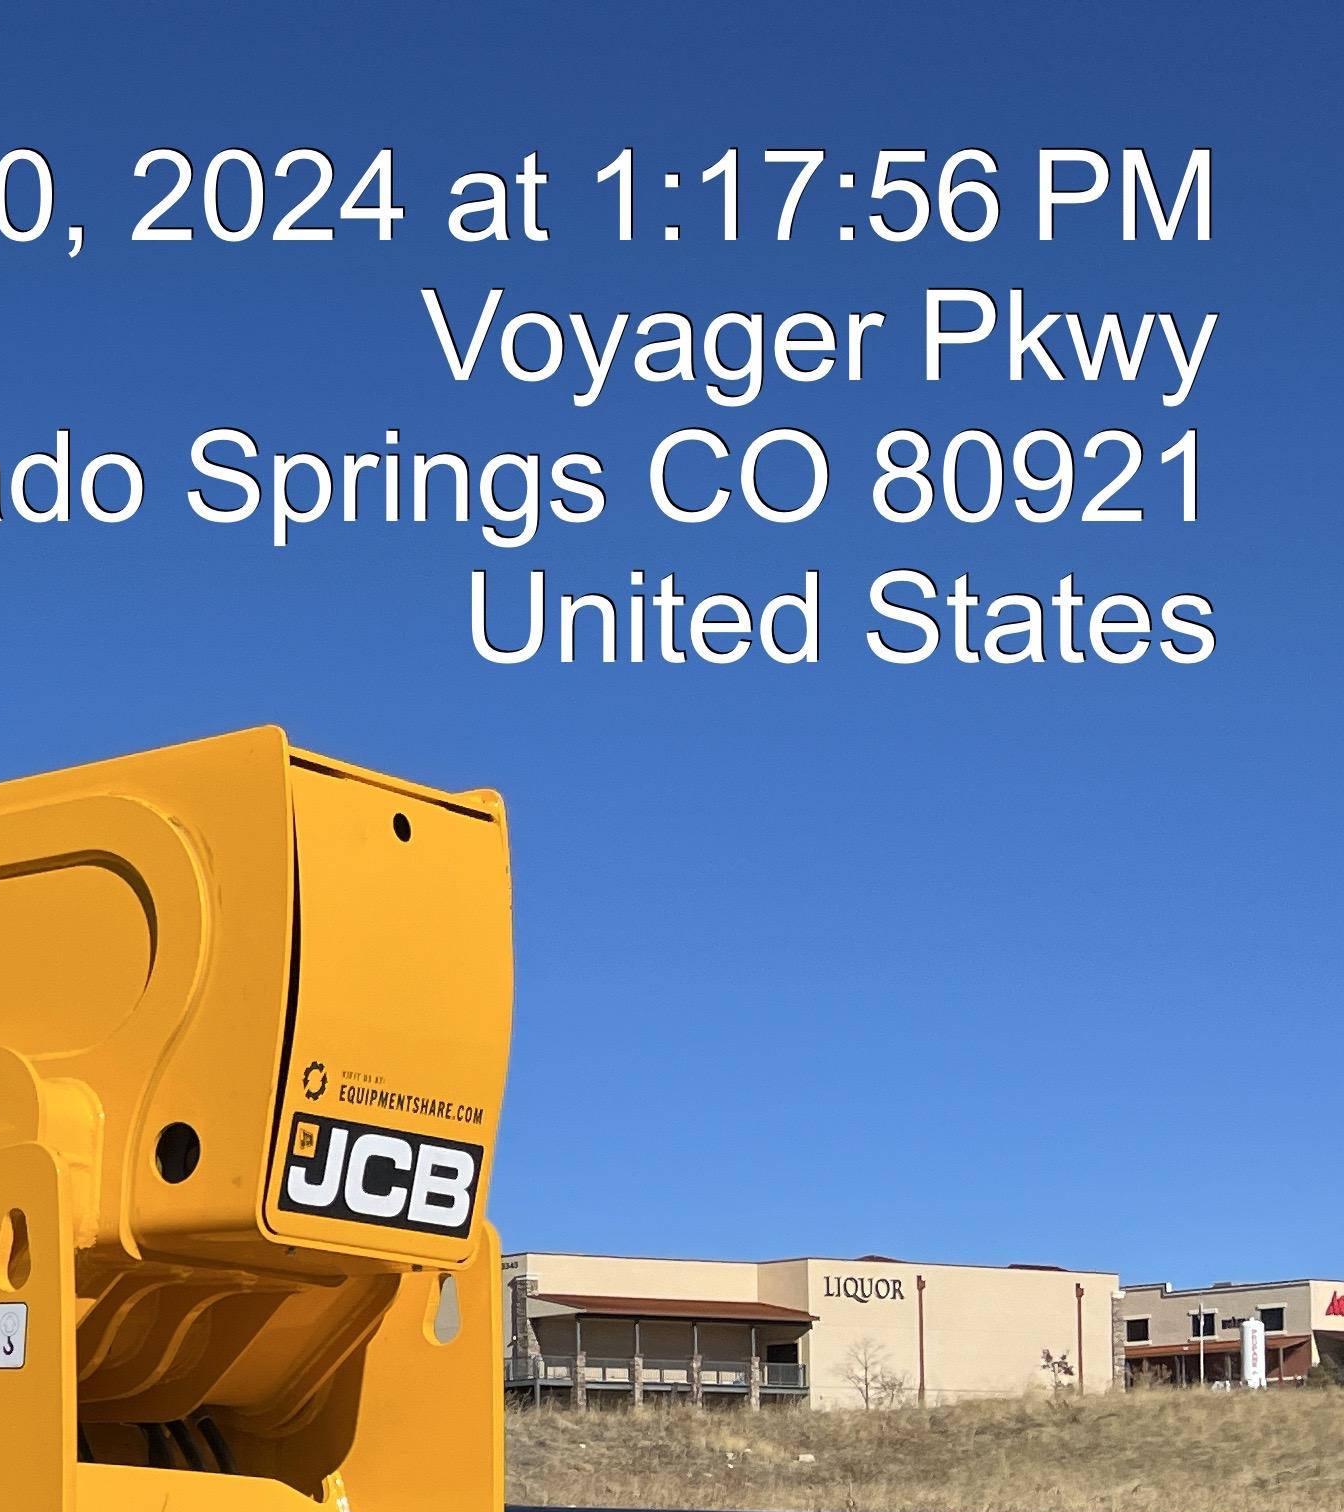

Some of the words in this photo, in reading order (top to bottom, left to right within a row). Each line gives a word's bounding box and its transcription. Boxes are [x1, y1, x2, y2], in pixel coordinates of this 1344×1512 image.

[339, 1084, 484, 1125] EQUIPMENTSHARE.COM
[287, 1127, 475, 1228] JCB
[823, 1275, 905, 1304] LIQUOR
